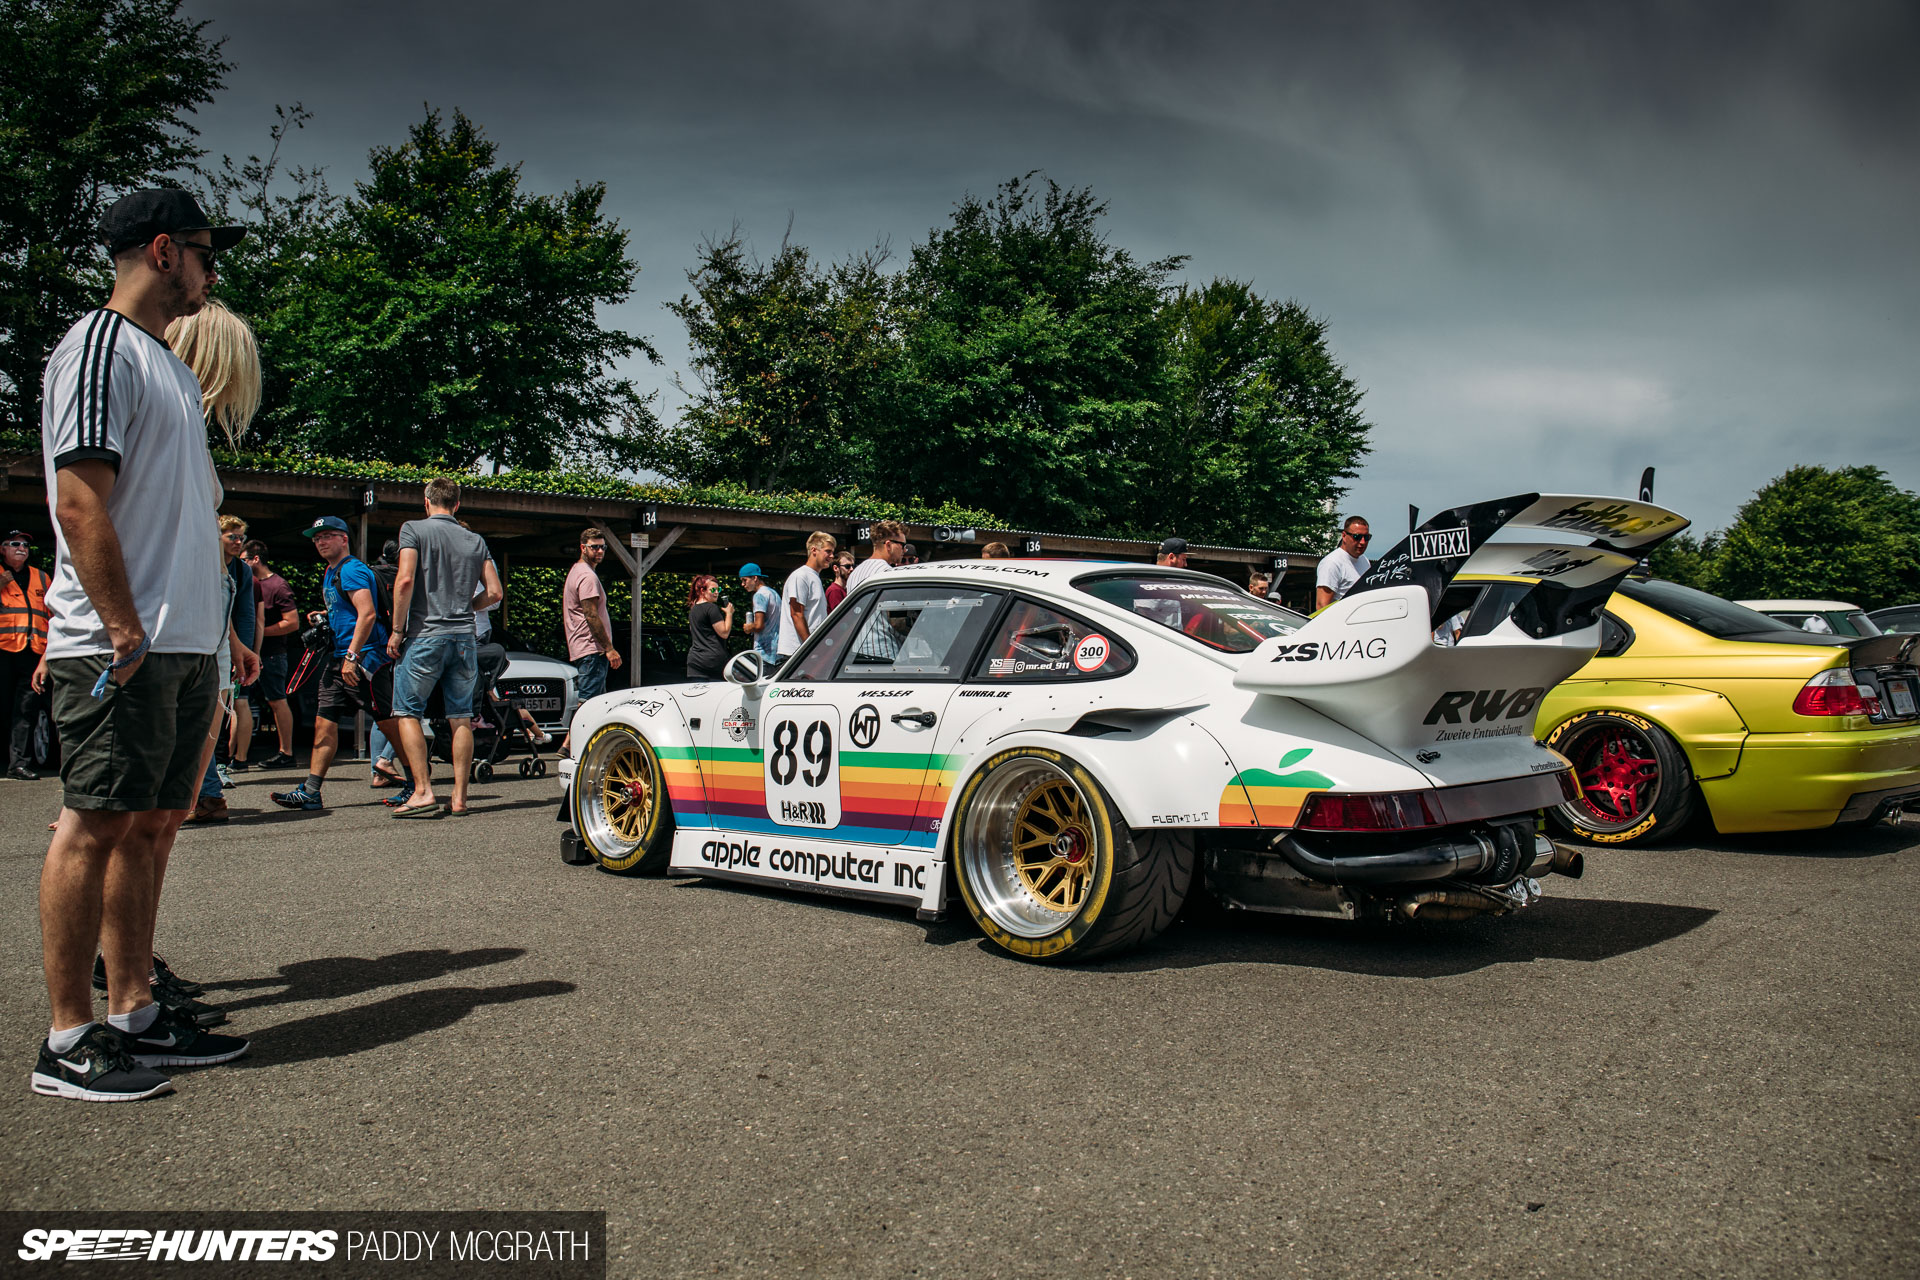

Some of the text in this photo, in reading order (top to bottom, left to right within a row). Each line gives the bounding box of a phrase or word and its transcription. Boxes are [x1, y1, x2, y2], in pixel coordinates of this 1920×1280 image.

[363, 490, 374, 506] 133
[642, 511, 657, 526] 134
[857, 527, 871, 540] 135
[1026, 541, 1041, 552] 136
[1413, 530, 1467, 558] LXYRXX
[1274, 558, 1288, 569] 138
[1080, 646, 1104, 657] 300
[1025, 661, 1070, 671] mr.ed_911
[857, 690, 914, 698] MESSER
[1422, 687, 1545, 725] RWB
[1435, 724, 1523, 742] Zweite Entwicklung
[770, 719, 832, 788] 89
[781, 800, 809, 821] H&R
[701, 839, 761, 869] apple
[769, 848, 885, 884] computer
